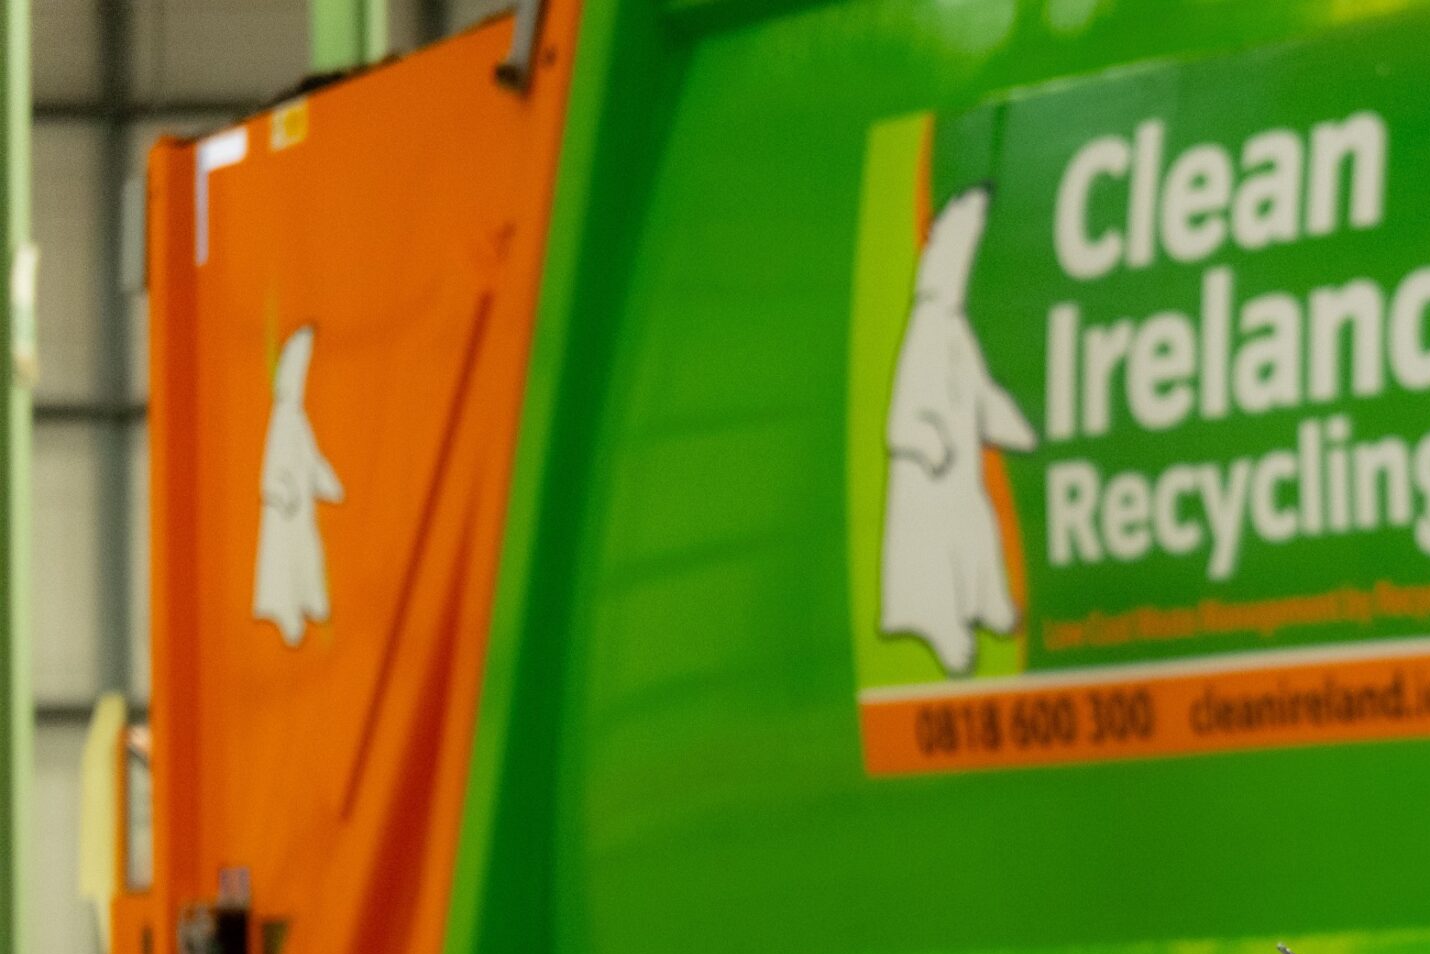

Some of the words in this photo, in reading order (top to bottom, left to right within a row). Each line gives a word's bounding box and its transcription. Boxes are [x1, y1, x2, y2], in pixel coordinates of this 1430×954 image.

[1053, 111, 1387, 280] Clean
[914, 697, 1001, 756] 0818
[1010, 692, 1077, 749] 600
[1088, 688, 1155, 743] 300
